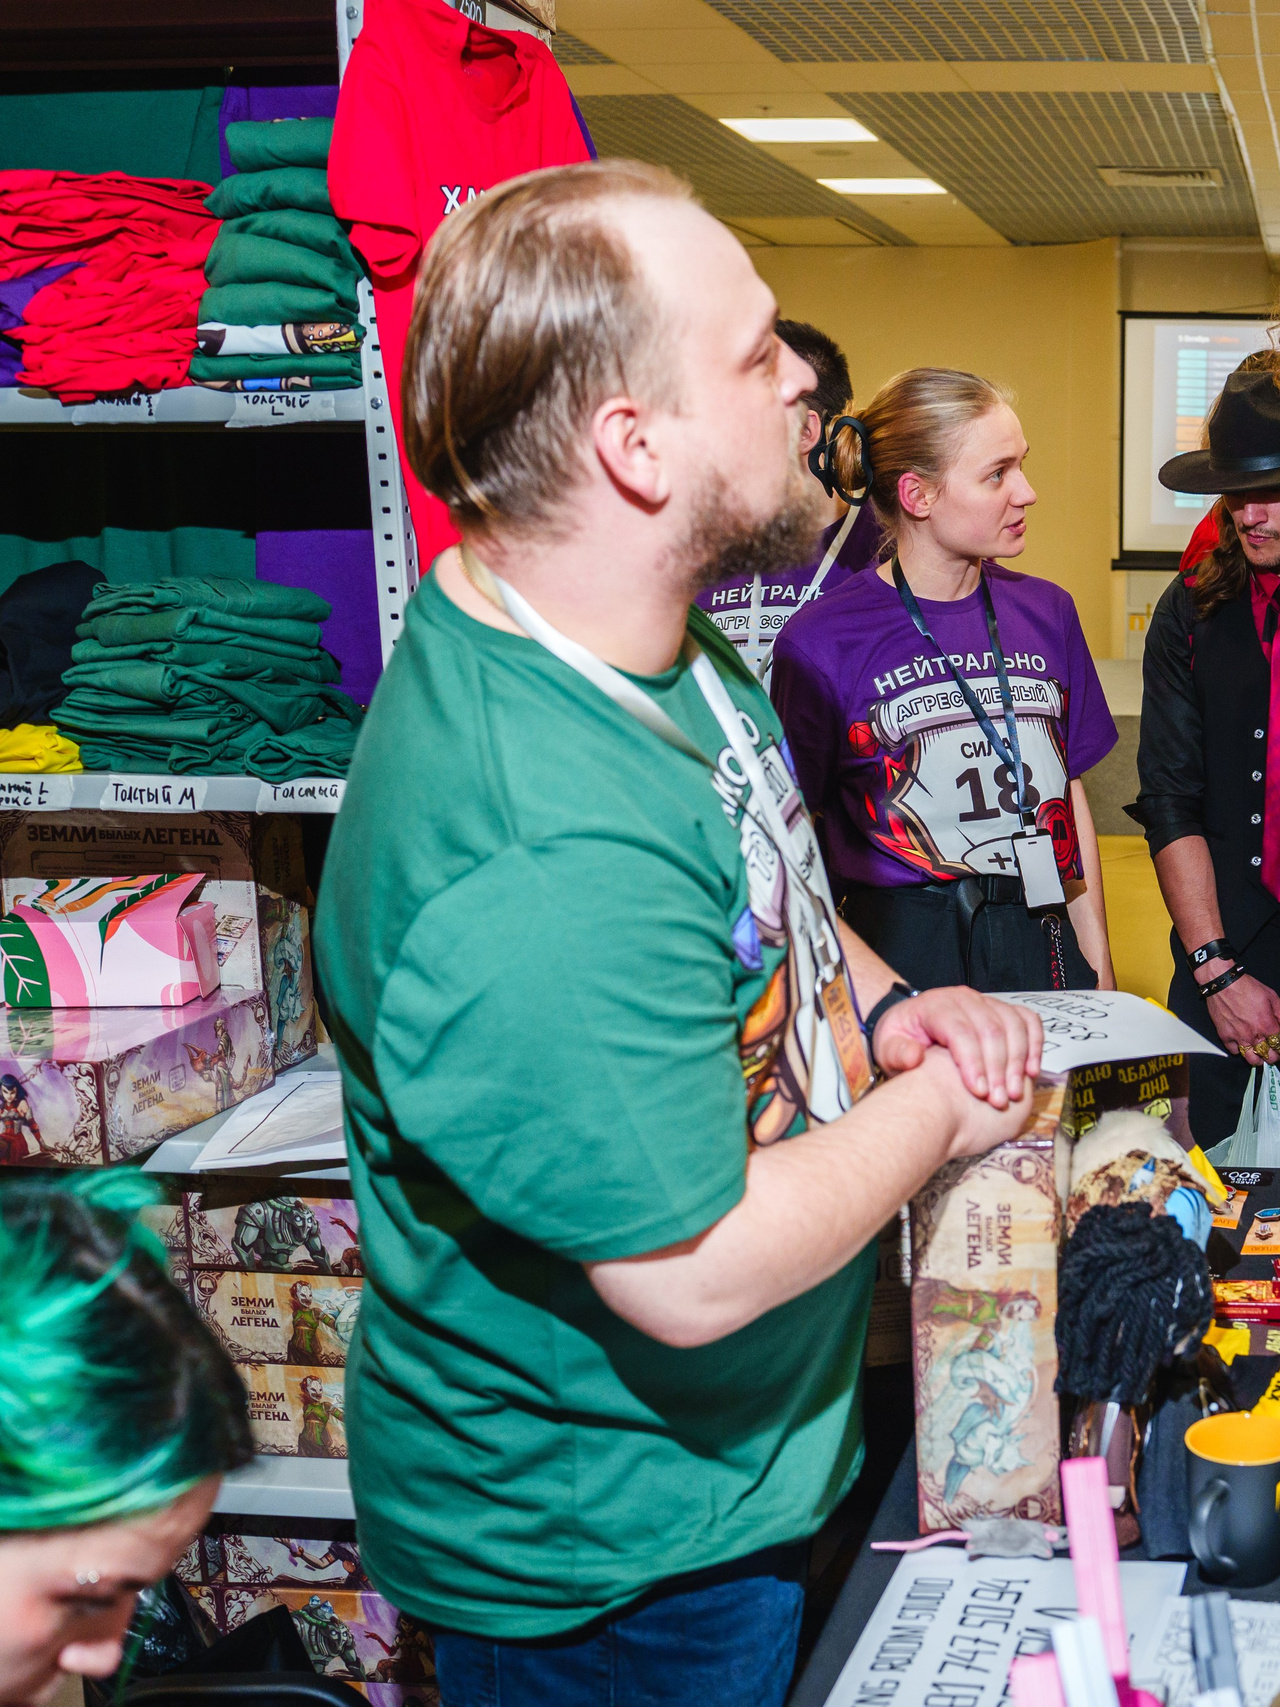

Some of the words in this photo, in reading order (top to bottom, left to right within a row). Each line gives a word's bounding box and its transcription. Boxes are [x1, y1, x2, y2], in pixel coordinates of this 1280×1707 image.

[896, 682, 1050, 723] АГРЕСИВНЫЙ
[955, 761, 1042, 823] 18
[27, 824, 97, 843] ЗЕМЛИ
[142, 827, 224, 846] ЛЕГЕНД
[1117, 1053, 1184, 1084] АБАЖАЮ
[131, 1070, 161, 1092] ЗЕМЛИ
[1138, 1073, 1170, 1102] ДНД
[132, 1092, 165, 1116] ЛЕГЕНД
[966, 1198, 982, 1270] ЛЕГЕНД
[996, 1203, 1012, 1266] ЗЕМЛИ
[230, 1296, 275, 1308] ЗЕМЛИ
[240, 1308, 267, 1316] БЫЛЫХ
[230, 1316, 281, 1328] ЛЕГЕНД
[249, 1391, 285, 1402] ЕМЛИ
[251, 1402, 278, 1410] БЫЛЫХ
[249, 1411, 291, 1421] ЕГЕНД
[937, 1634, 1001, 1675] 747
